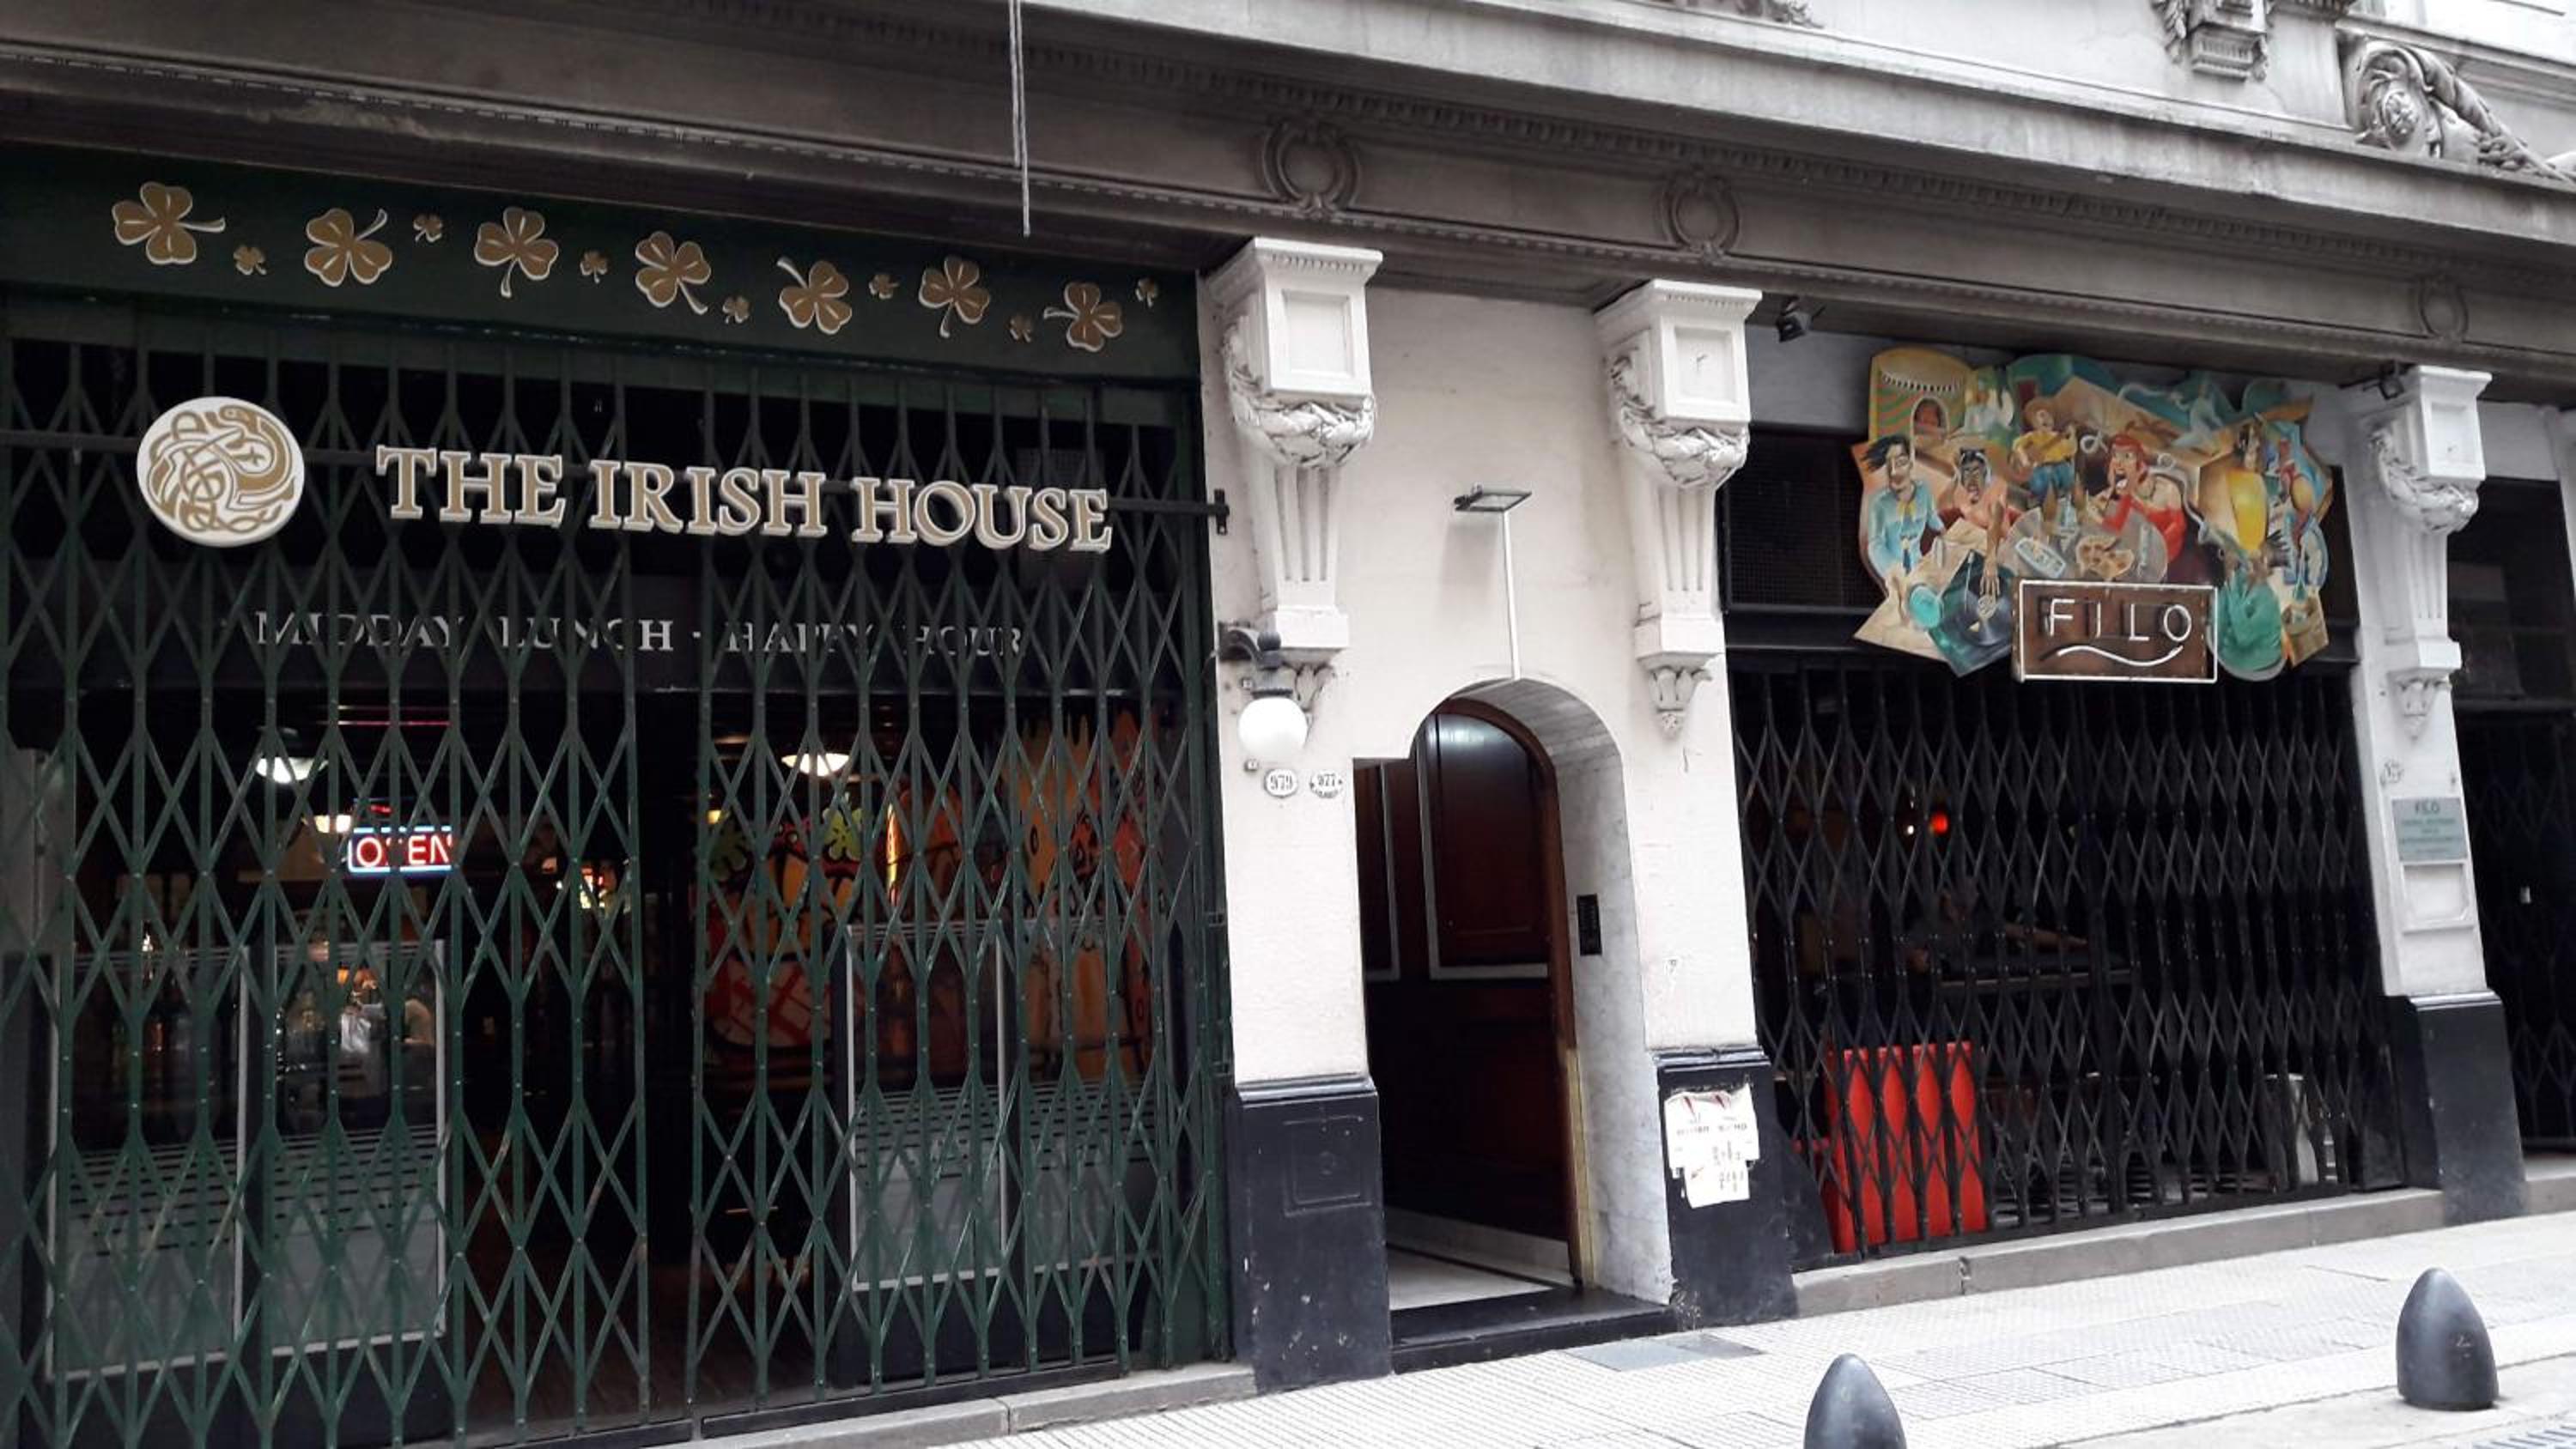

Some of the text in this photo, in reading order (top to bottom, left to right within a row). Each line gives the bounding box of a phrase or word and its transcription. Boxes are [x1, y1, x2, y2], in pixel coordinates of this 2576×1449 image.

[376, 444, 1113, 555] THE IRISH HOUSE
[2049, 597, 2192, 642] FILO
[355, 833, 453, 868] OEN
